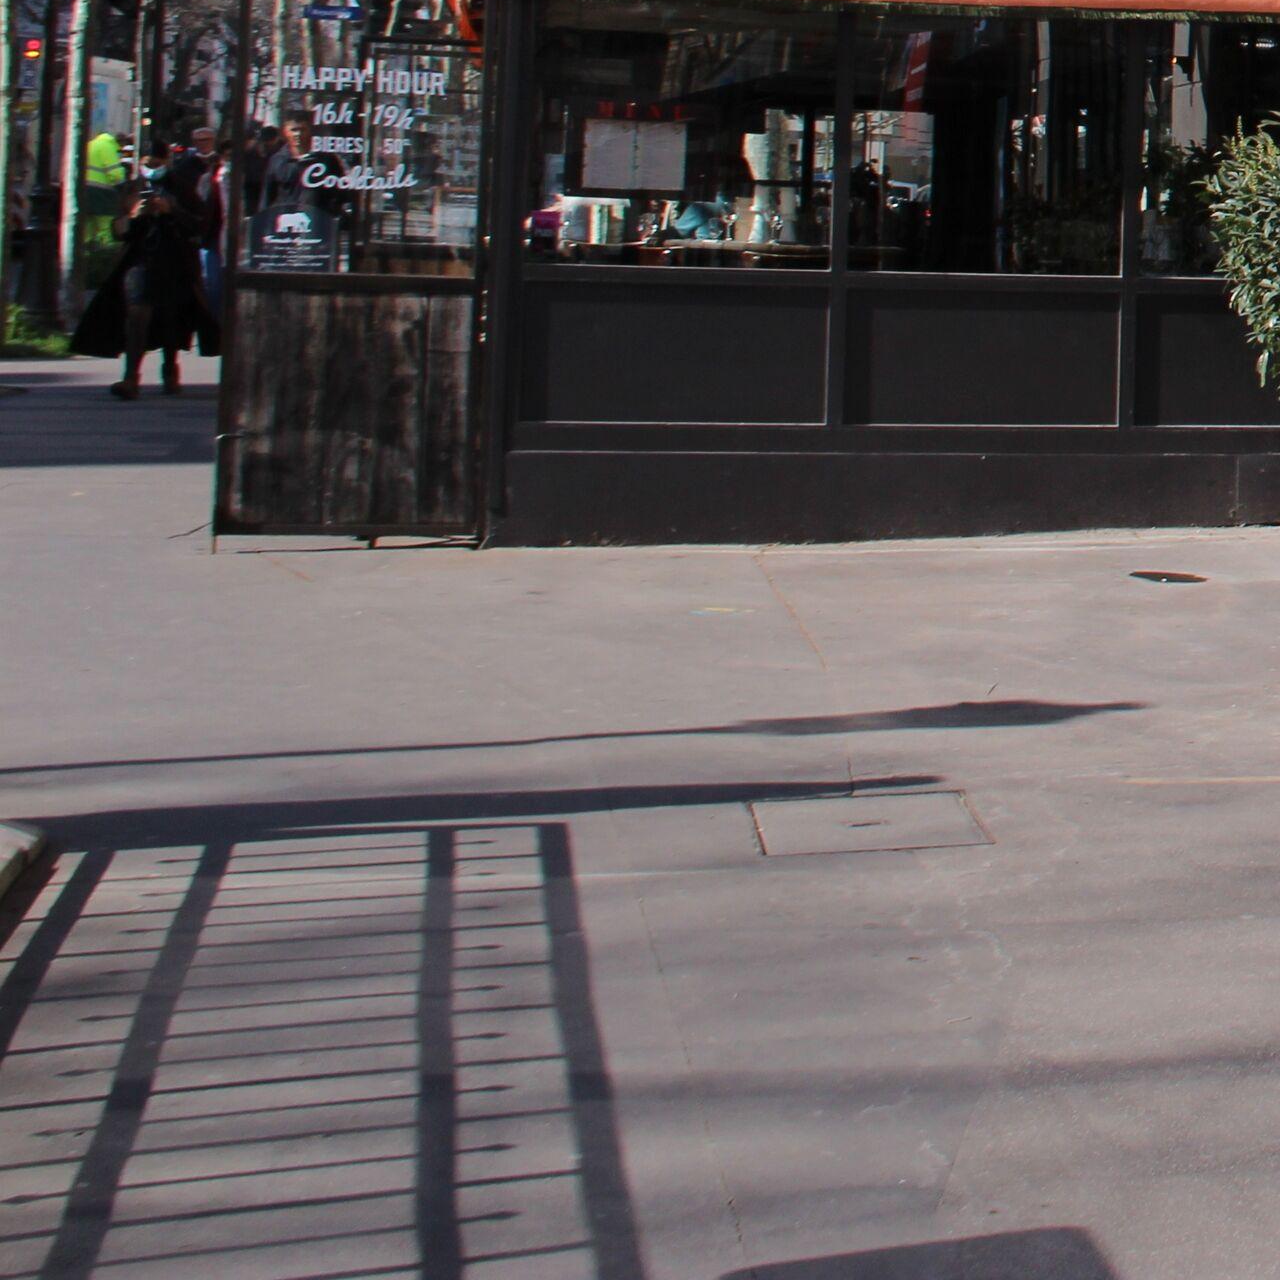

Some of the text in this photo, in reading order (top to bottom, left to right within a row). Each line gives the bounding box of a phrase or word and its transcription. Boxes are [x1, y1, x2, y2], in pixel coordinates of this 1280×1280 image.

[281, 64, 447, 97] HAPPY HOUR
[312, 103, 354, 126] 16h
[372, 103, 416, 131] 19h
[309, 135, 364, 154] BIERES
[302, 162, 419, 191] Cocktails
